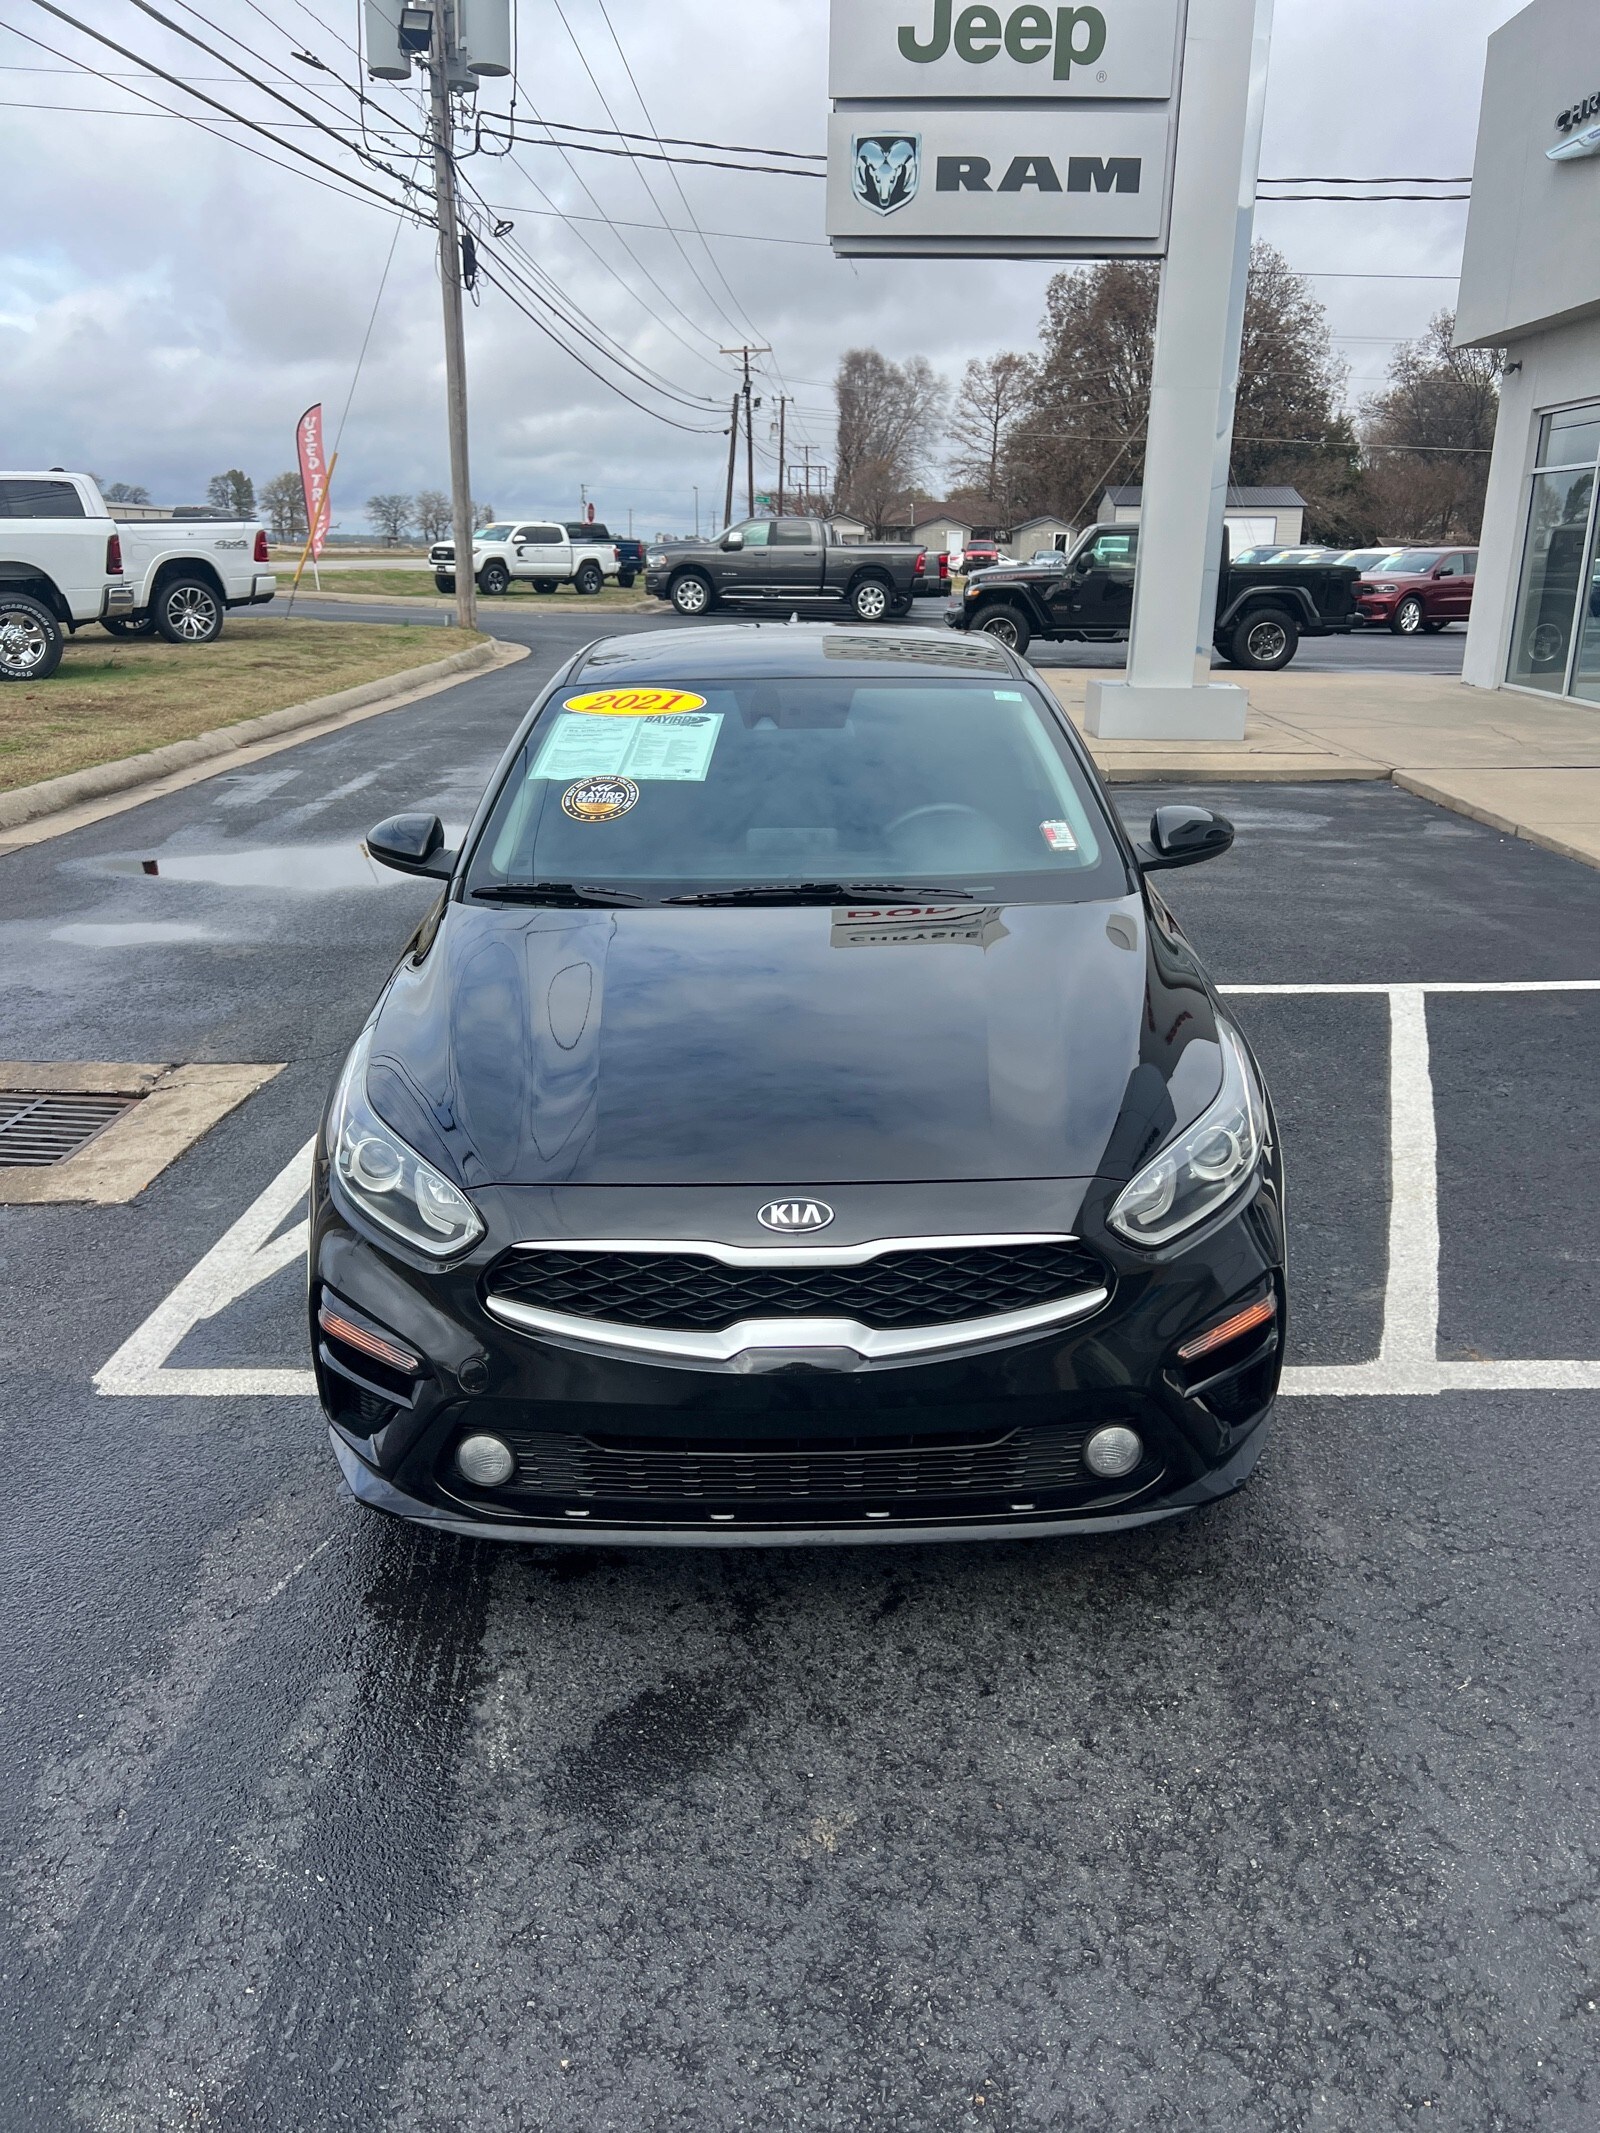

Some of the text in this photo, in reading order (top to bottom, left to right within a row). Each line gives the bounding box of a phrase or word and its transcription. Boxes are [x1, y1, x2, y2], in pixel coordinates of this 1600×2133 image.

[898, 0, 1107, 81] Jeep
[935, 156, 1142, 194] RAM
[303, 416, 320, 470] USED
[584, 694, 684, 711] 2021
[577, 790, 625, 799] BAYIRD
[770, 1203, 822, 1225] KIA
